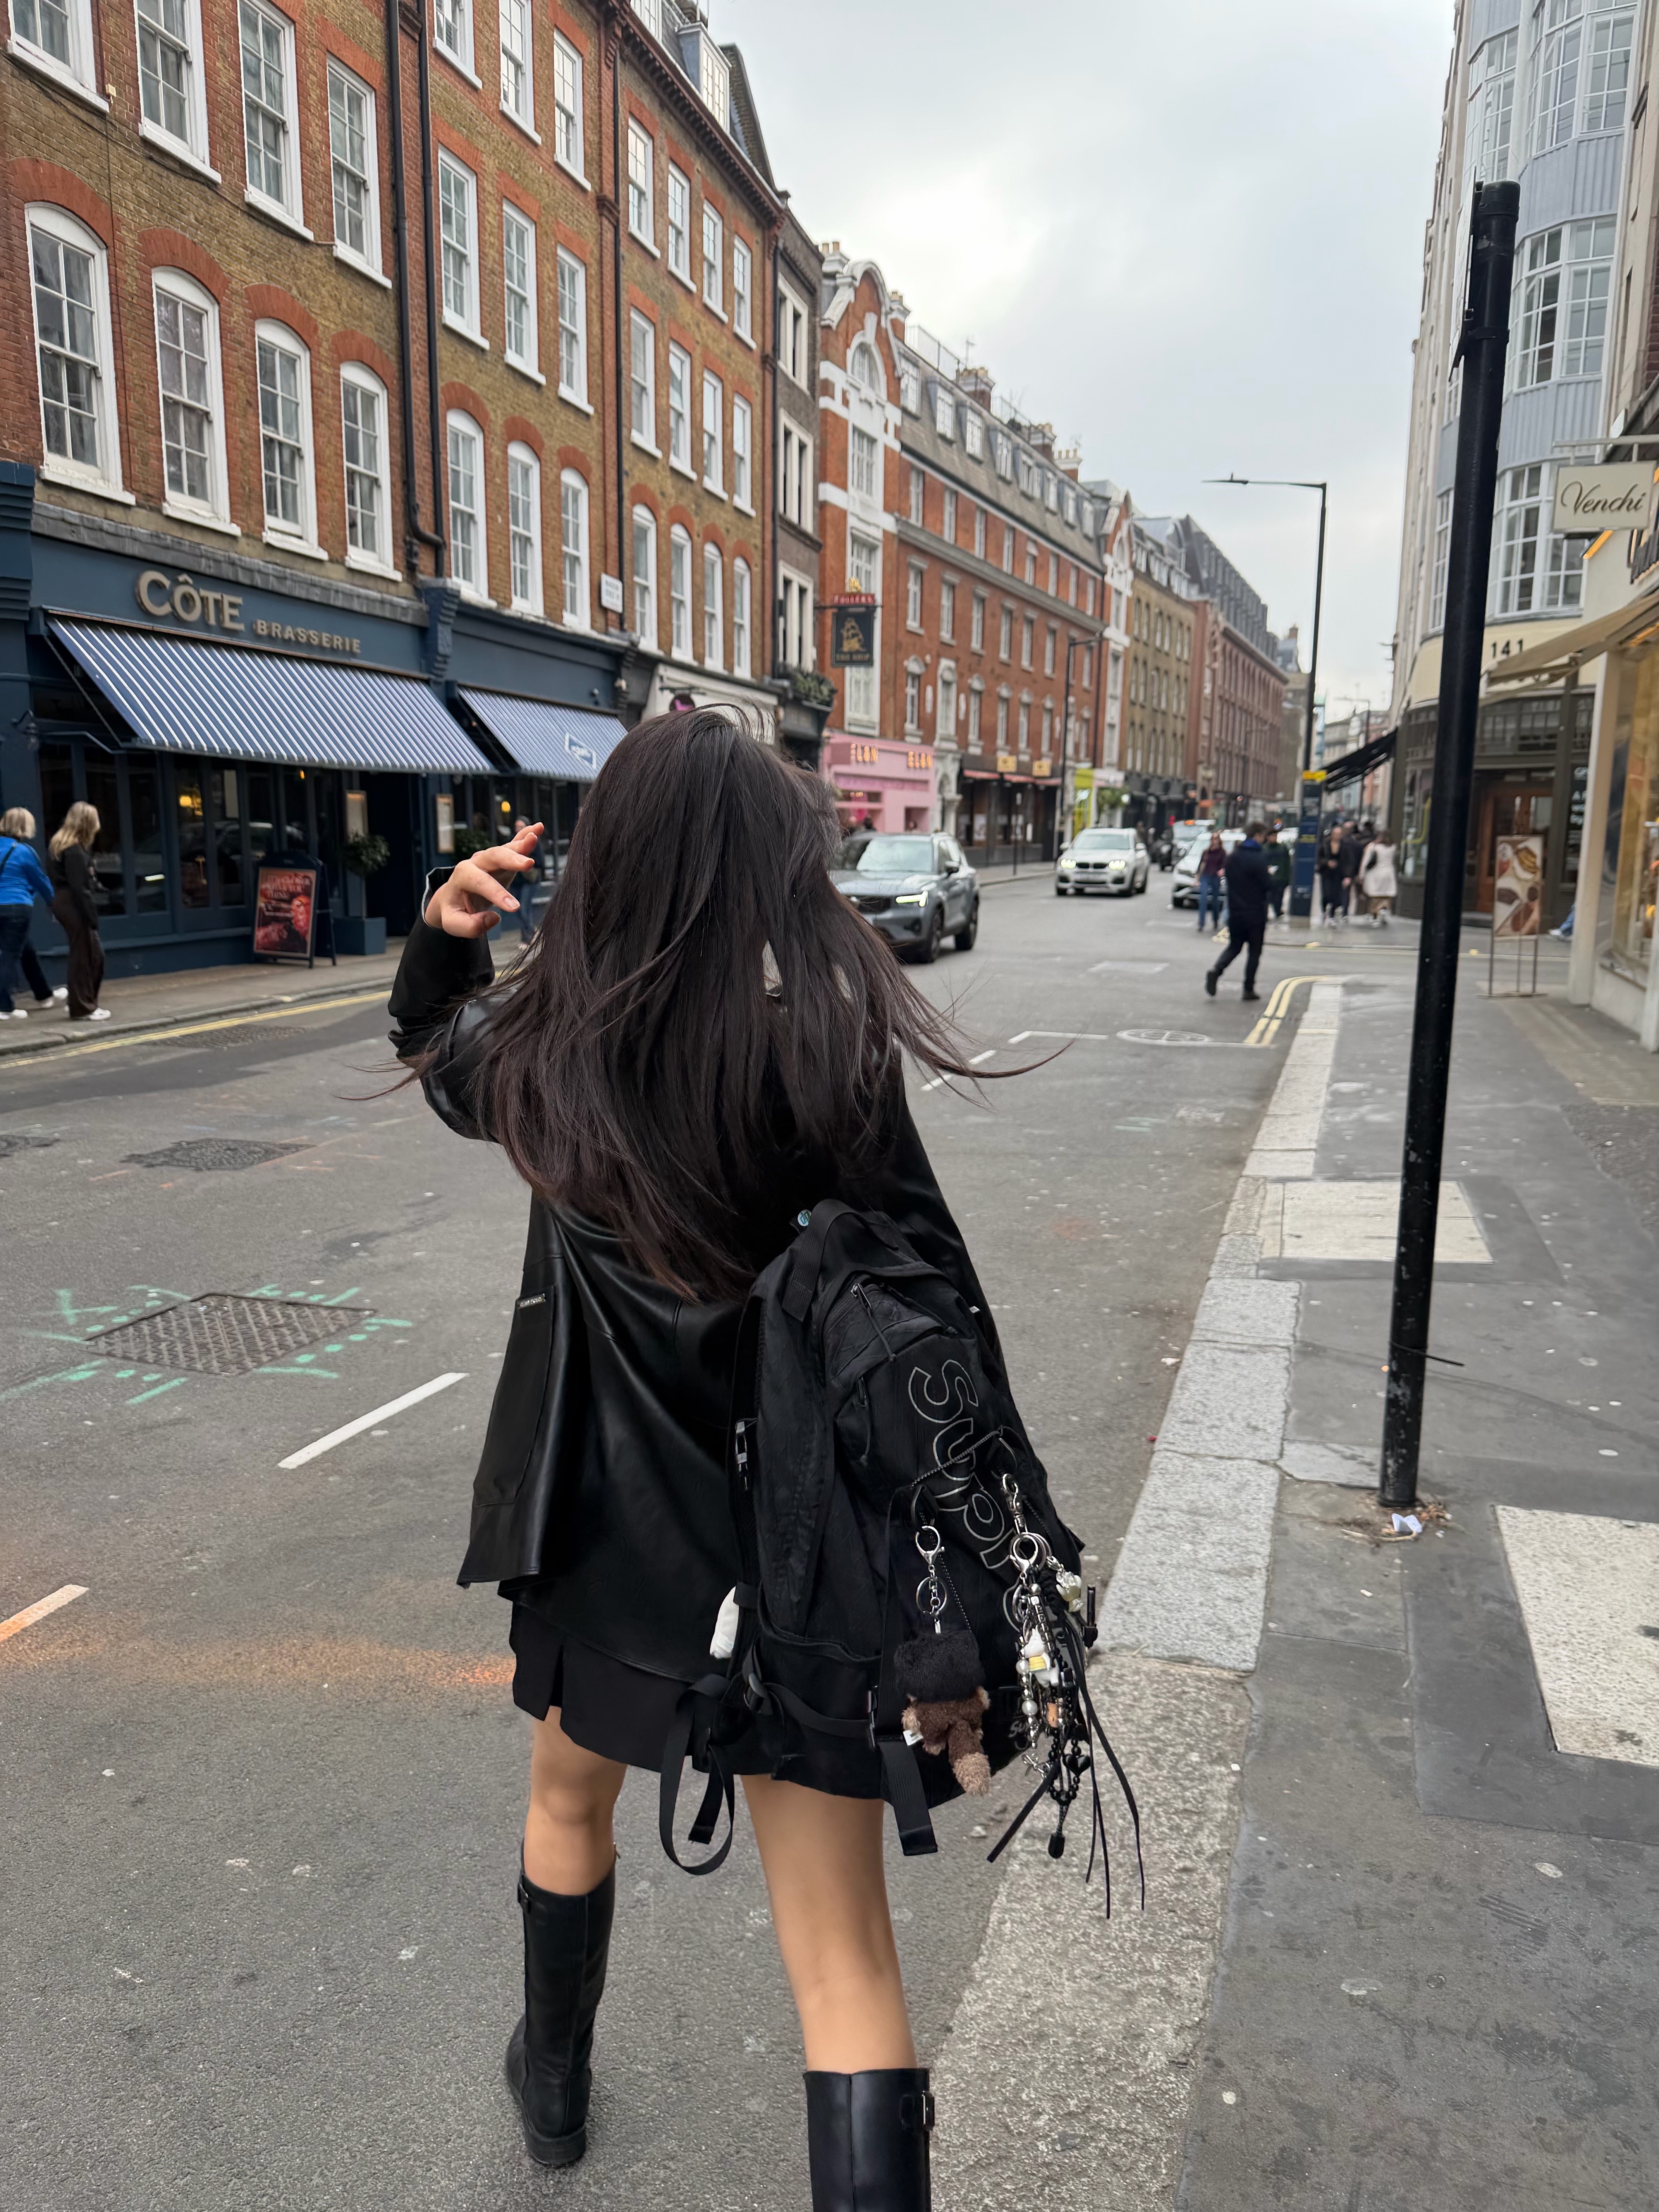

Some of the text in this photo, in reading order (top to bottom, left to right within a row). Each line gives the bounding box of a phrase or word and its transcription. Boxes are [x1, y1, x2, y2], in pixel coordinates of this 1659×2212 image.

[1561, 481, 1646, 514] Venchi
[138, 570, 361, 654] CÔTE BRASSERIE
[1492, 638, 1523, 658] 141
